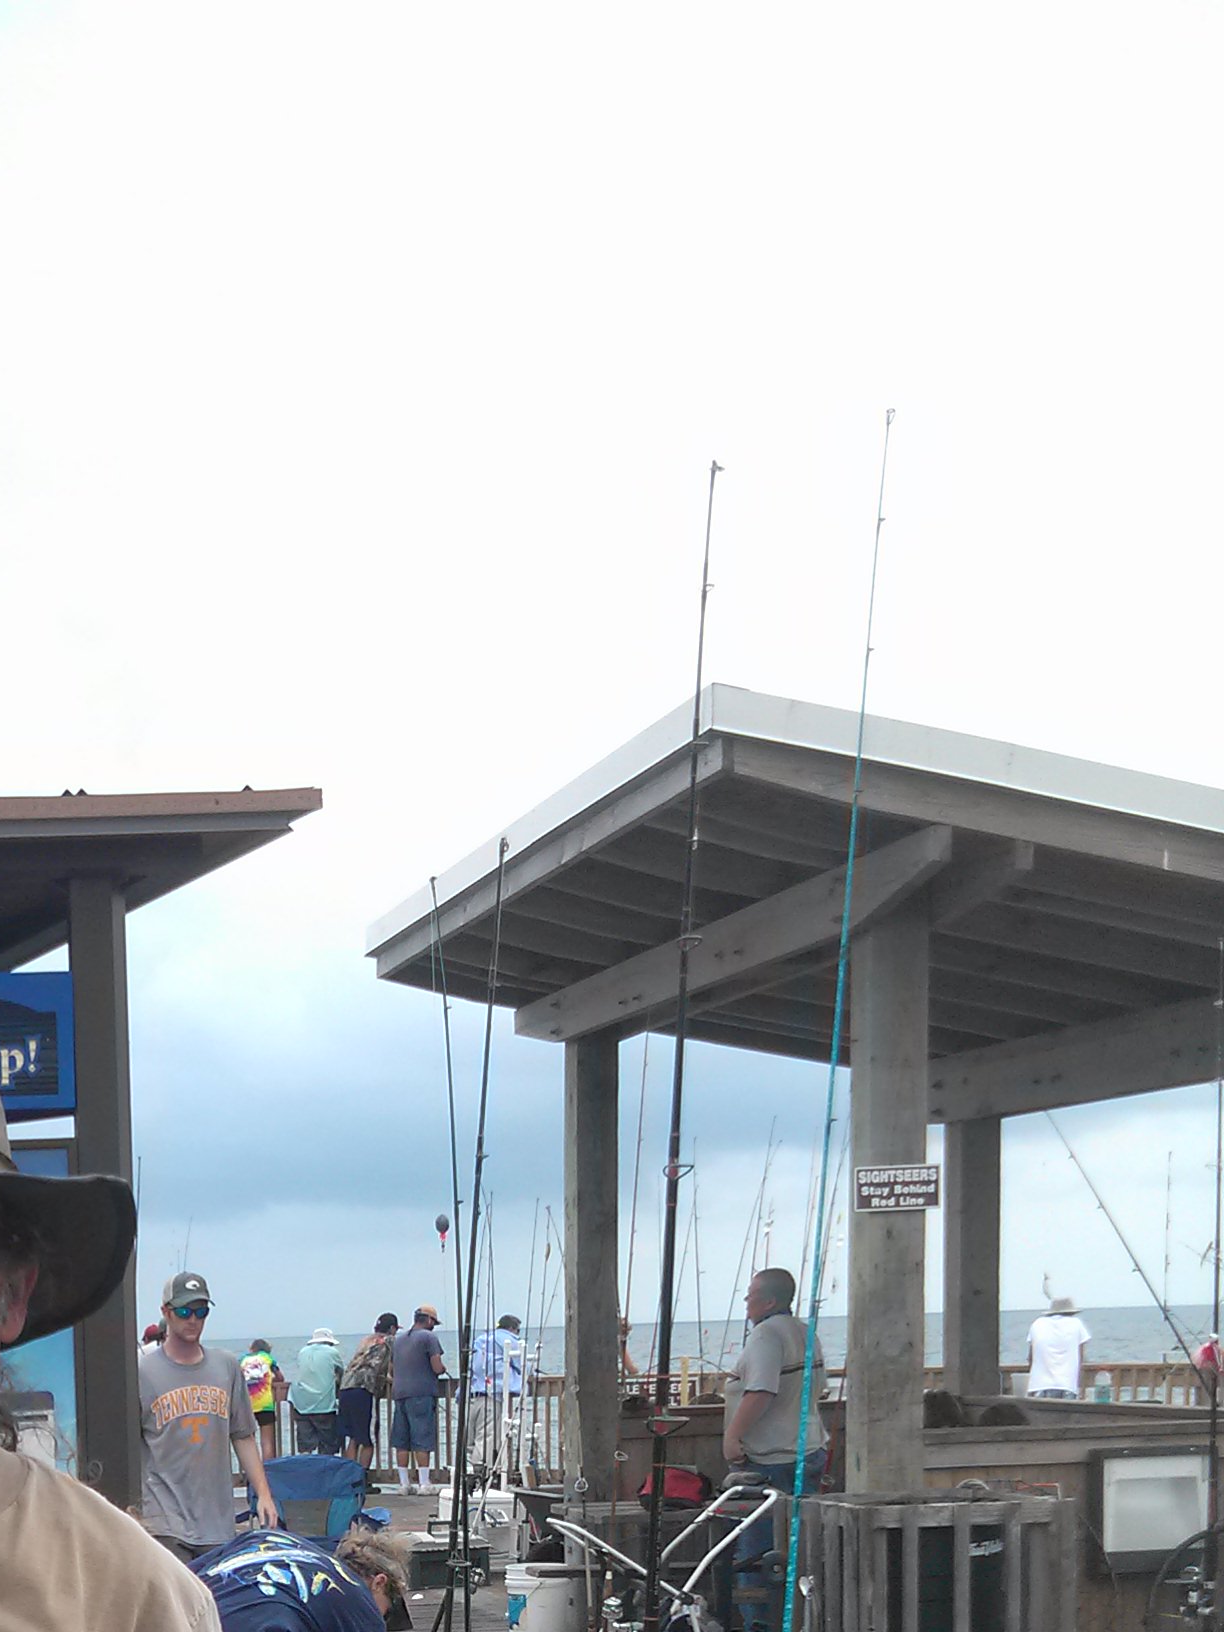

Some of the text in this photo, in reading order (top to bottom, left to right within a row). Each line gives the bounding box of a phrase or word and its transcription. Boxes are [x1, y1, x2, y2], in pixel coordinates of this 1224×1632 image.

[858, 1168, 937, 1184] SIGHTSEERS
[861, 1183, 935, 1197] Stay Behind
[870, 1195, 925, 1207] Red Line
[150, 1385, 229, 1430] TENNESSE
[180, 1415, 209, 1443] T
